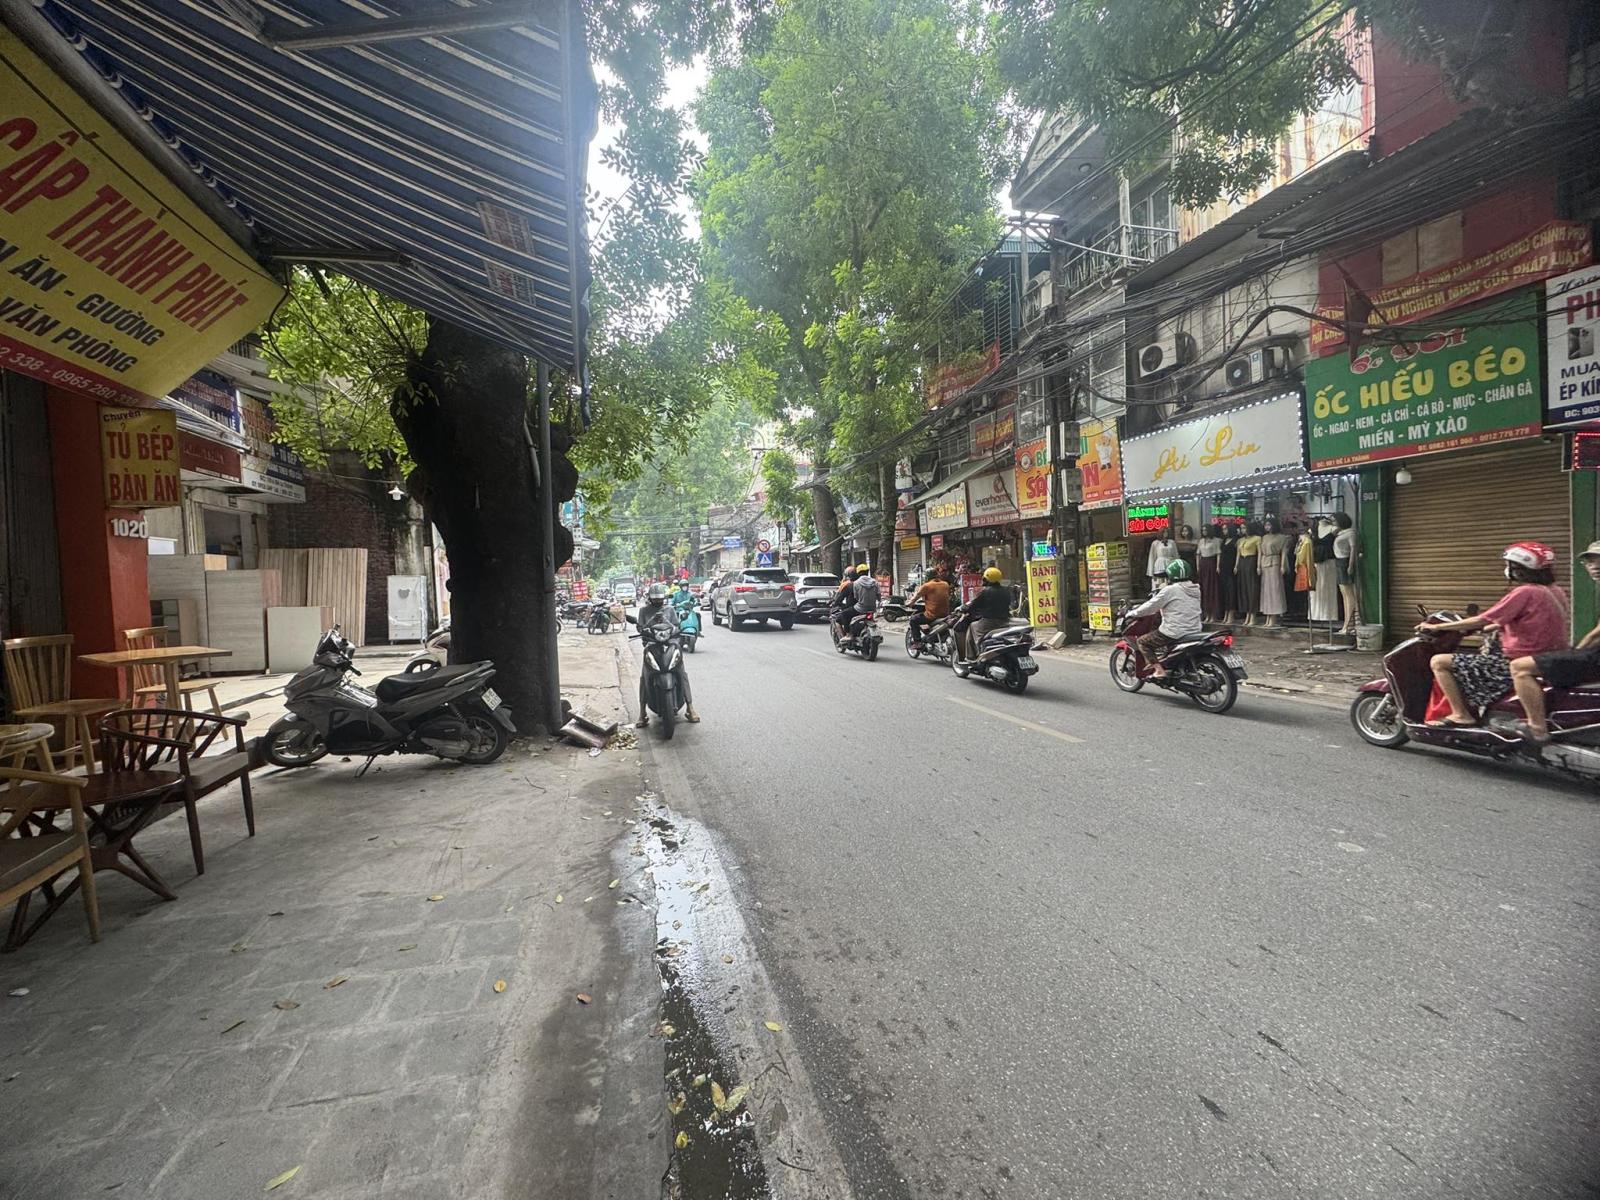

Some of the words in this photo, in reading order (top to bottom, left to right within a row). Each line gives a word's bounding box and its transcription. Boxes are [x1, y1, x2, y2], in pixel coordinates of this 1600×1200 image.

[1532, 225, 1566, 249] CHÍNH
[46, 184, 194, 296] THÀNH
[151, 261, 250, 333] PHÁT
[1512, 250, 1548, 280] PHÁP
[7, 254, 67, 292] ĂN
[76, 293, 165, 346] GIƯỜNG
[51, 327, 138, 373] PHÒNG
[9, 352, 45, 371] 338
[52, 369, 93, 389] 0965
[88, 383, 116, 400] 280
[1314, 384, 1350, 419] ỐC
[1359, 362, 1435, 409] HIẾU
[1448, 345, 1527, 389] BÉO
[1561, 361, 1600, 378] MUA
[1560, 381, 1577, 400] ÉP
[1581, 376, 1600, 397] KÍ
[1313, 423, 1323, 438] ỐC
[1329, 420, 1349, 435] NGAO
[1355, 415, 1374, 430] NEM
[1381, 408, 1393, 424] CÁ
[1417, 401, 1430, 417] CÁ
[1452, 393, 1476, 411] MỰC
[1484, 385, 1515, 403] CHÂN
[1517, 378, 1533, 396] GÀ
[105, 422, 131, 460] TỦ
[136, 425, 174, 461] BẾP
[1359, 427, 1394, 449] MIẾN
[1435, 415, 1468, 435] XÀO
[109, 467, 148, 501] BÀN
[153, 468, 179, 501] ĂN
[1026, 471, 1048, 499] SÀ
[1031, 563, 1057, 577] BÁNH
[1037, 610, 1057, 624] GÒN
[1038, 595, 1056, 608] SÀI
